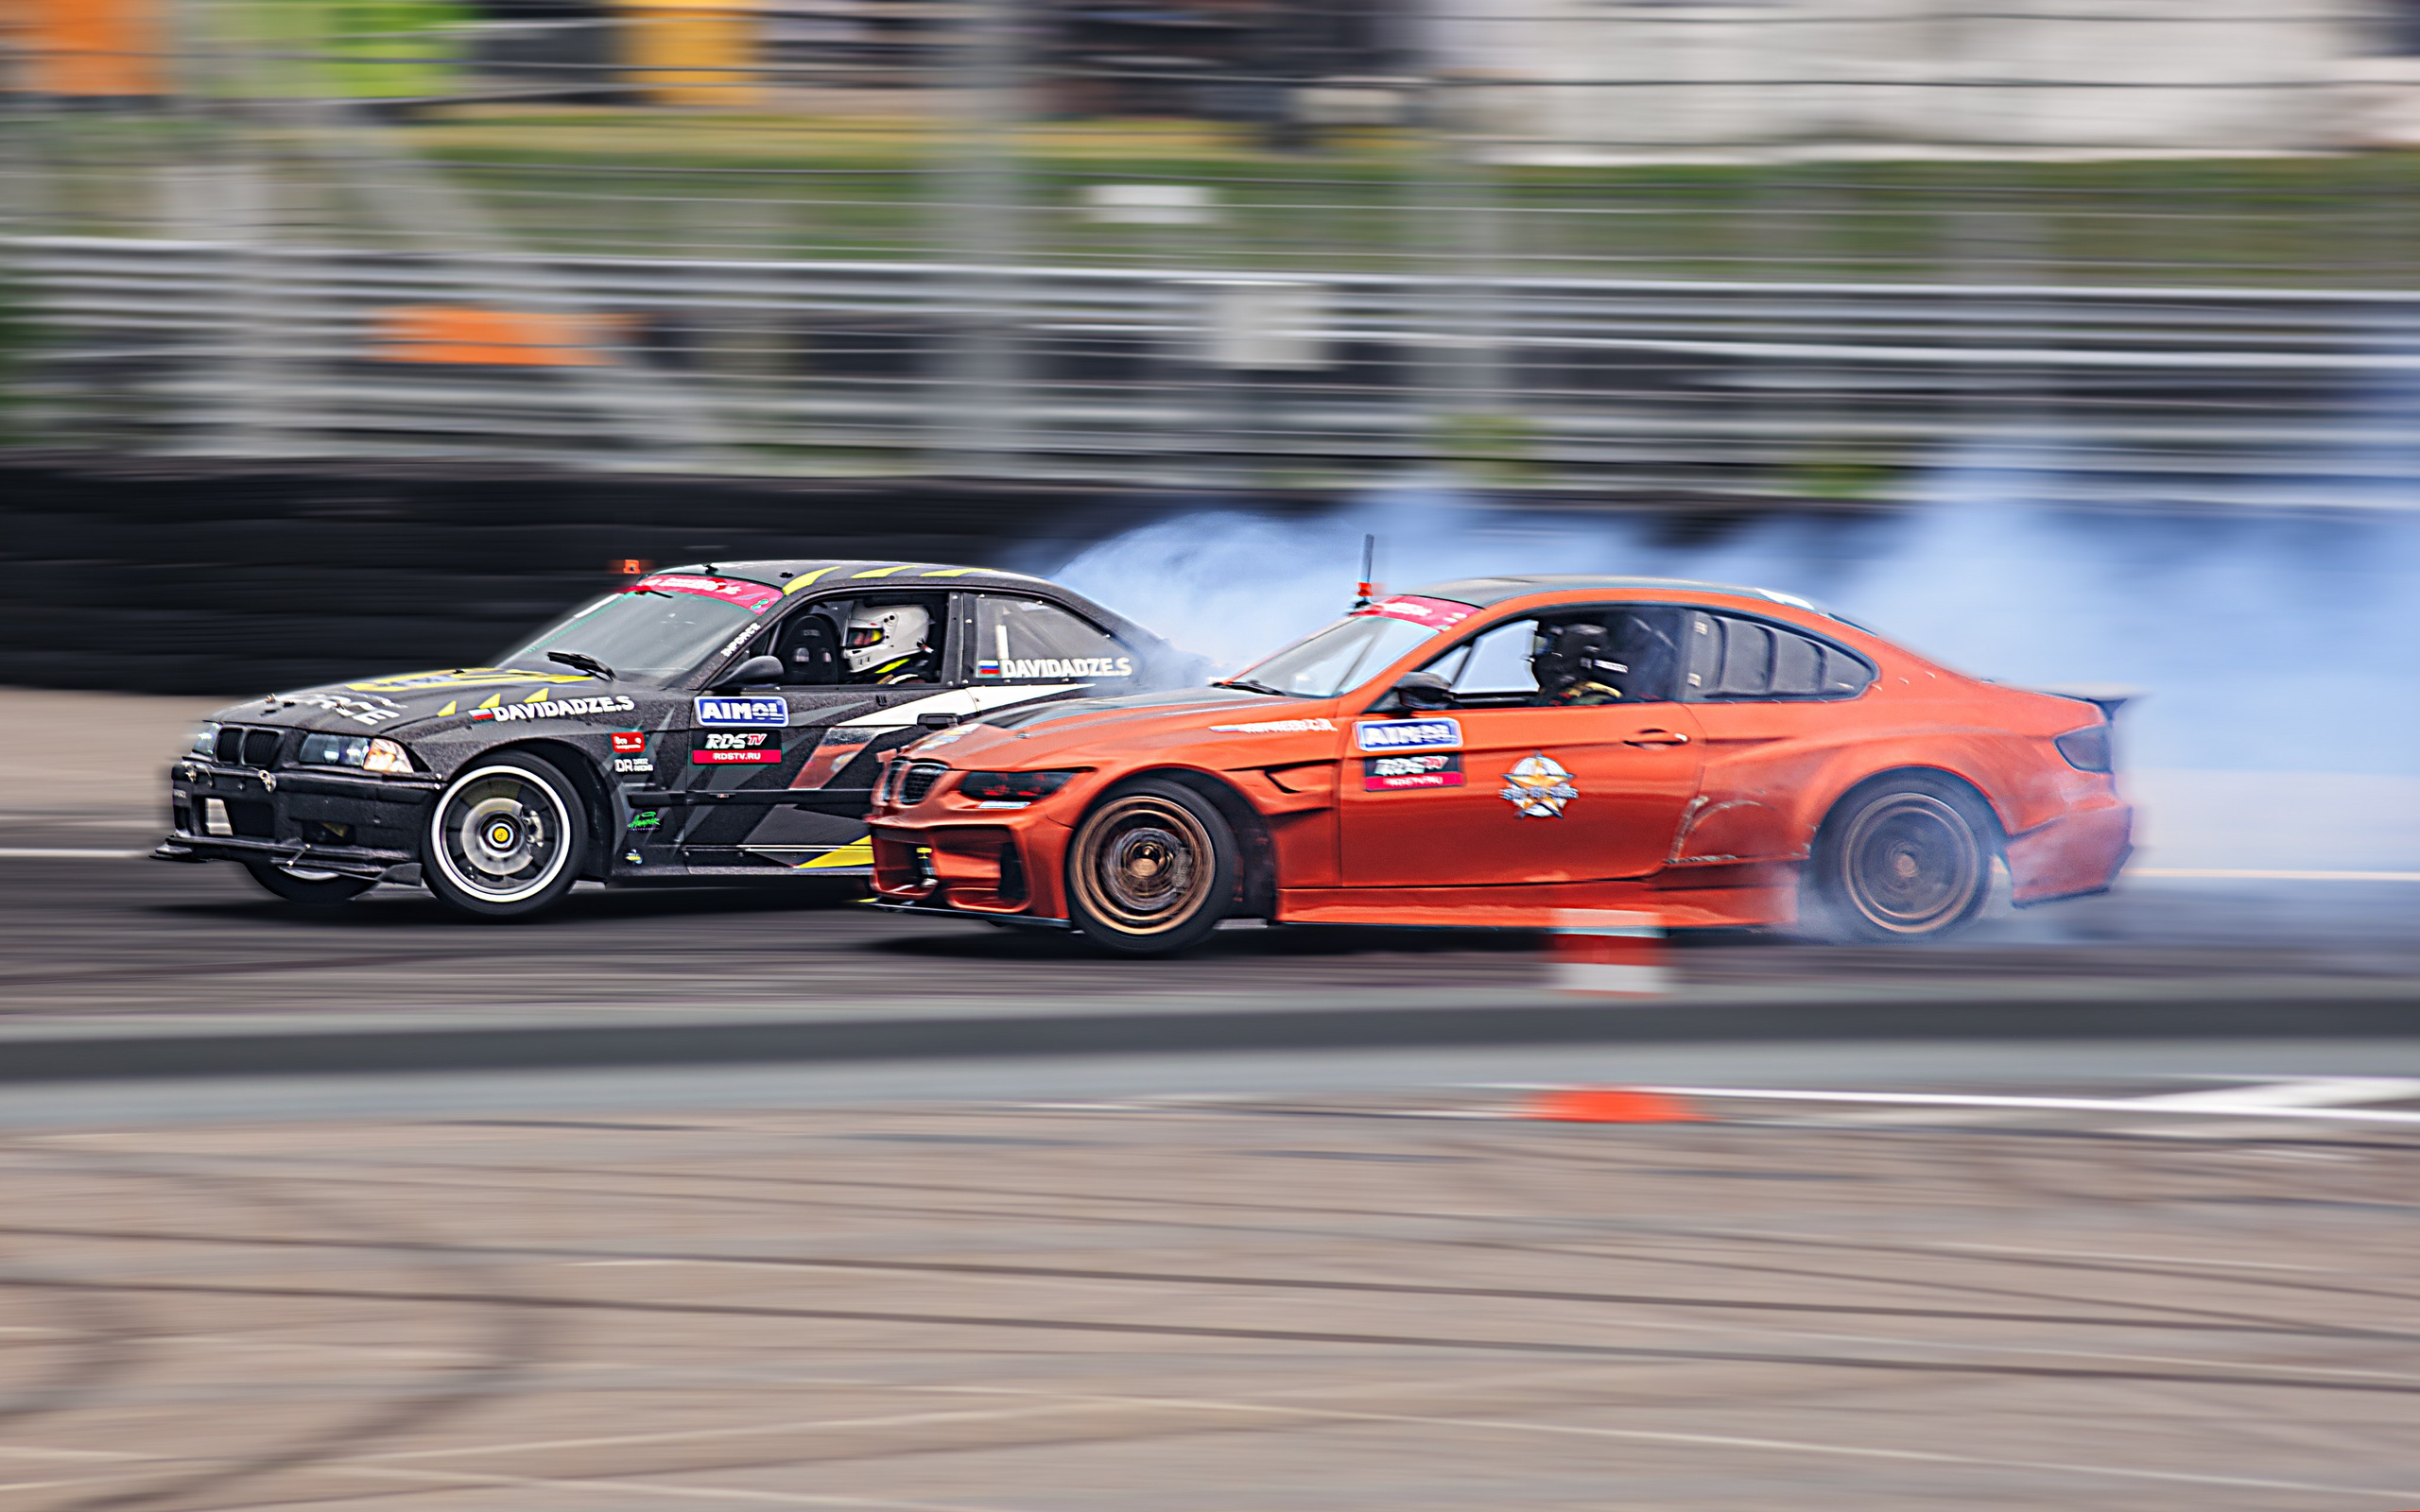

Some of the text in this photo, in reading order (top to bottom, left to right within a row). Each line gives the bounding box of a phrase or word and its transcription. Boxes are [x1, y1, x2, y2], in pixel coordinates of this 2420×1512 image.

[1002, 657, 1132, 678] DAVIDADZE.S
[492, 696, 635, 722] DAVIDADZE.S
[702, 702, 784, 721] AIMOL
[614, 759, 633, 772] DR
[713, 752, 761, 761] RDSTV.RU
